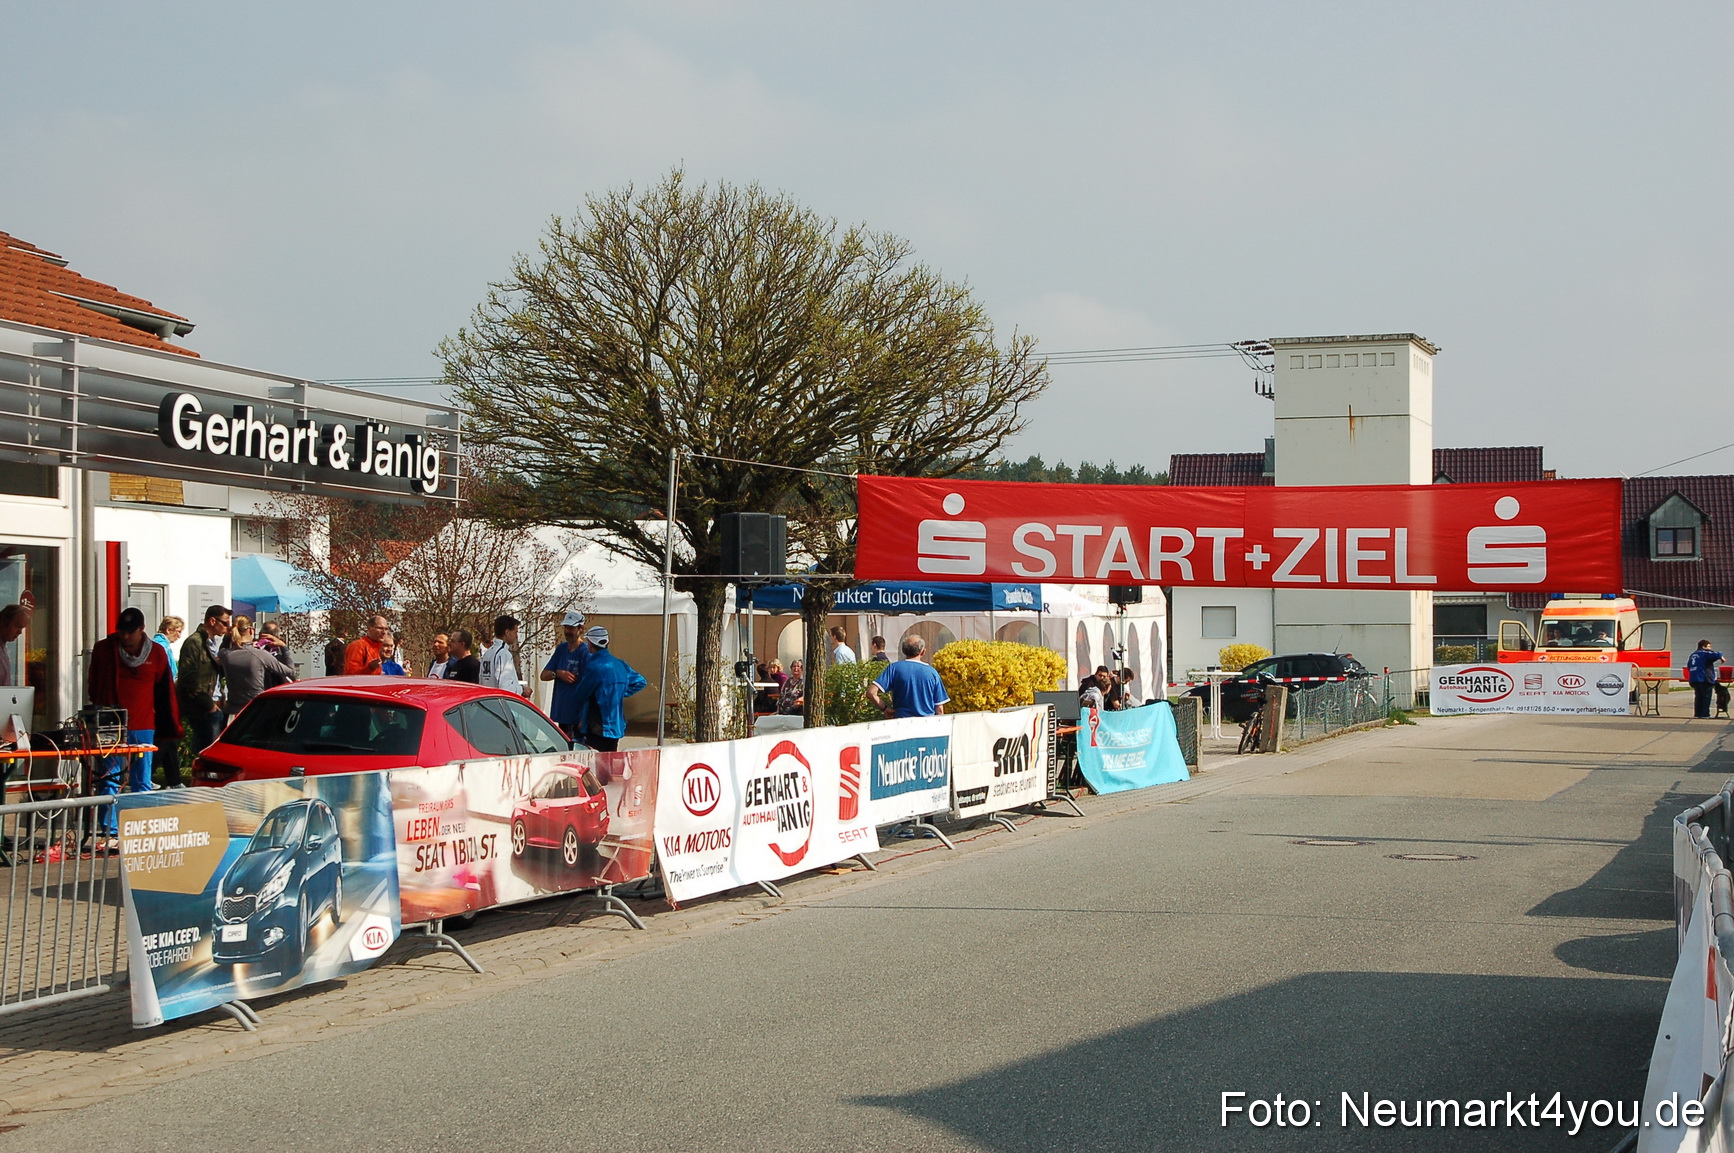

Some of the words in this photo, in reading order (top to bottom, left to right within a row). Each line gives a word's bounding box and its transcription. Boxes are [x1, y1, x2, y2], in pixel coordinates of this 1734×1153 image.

[160, 392, 319, 466] Gerhart
[327, 423, 350, 470] &
[356, 422, 439, 494] Jänig
[792, 587, 874, 604] Narkter
[875, 587, 934, 607] Tagblatt
[1438, 676, 1498, 685] GERHART
[1562, 678, 1581, 686] KIA
[687, 776, 715, 804] KIA
[745, 771, 800, 808] GERHART
[124, 819, 147, 837] EINE
[148, 816, 180, 834] SEINER
[406, 817, 441, 842] LEBEN.
[441, 824, 451, 836] DER
[838, 826, 869, 843] SEAT
[123, 837, 157, 855] VIELEN
[157, 830, 211, 854] QUALITÄTEN:
[415, 841, 447, 873] SEAT
[453, 836, 479, 866] IBIZA
[480, 833, 498, 861] ST.
[663, 835, 681, 858] KIA
[684, 826, 732, 854] MOTORS
[123, 856, 146, 873] SEINE
[146, 850, 185, 874] QUALITÄT.
[669, 870, 682, 884] The
[701, 862, 724, 879] Surprise
[142, 934, 158, 951] EUE
[159, 930, 175, 948] KIA
[175, 926, 202, 946] CEE'D.
[366, 932, 384, 946] KIA
[147, 950, 163, 968] OBE
